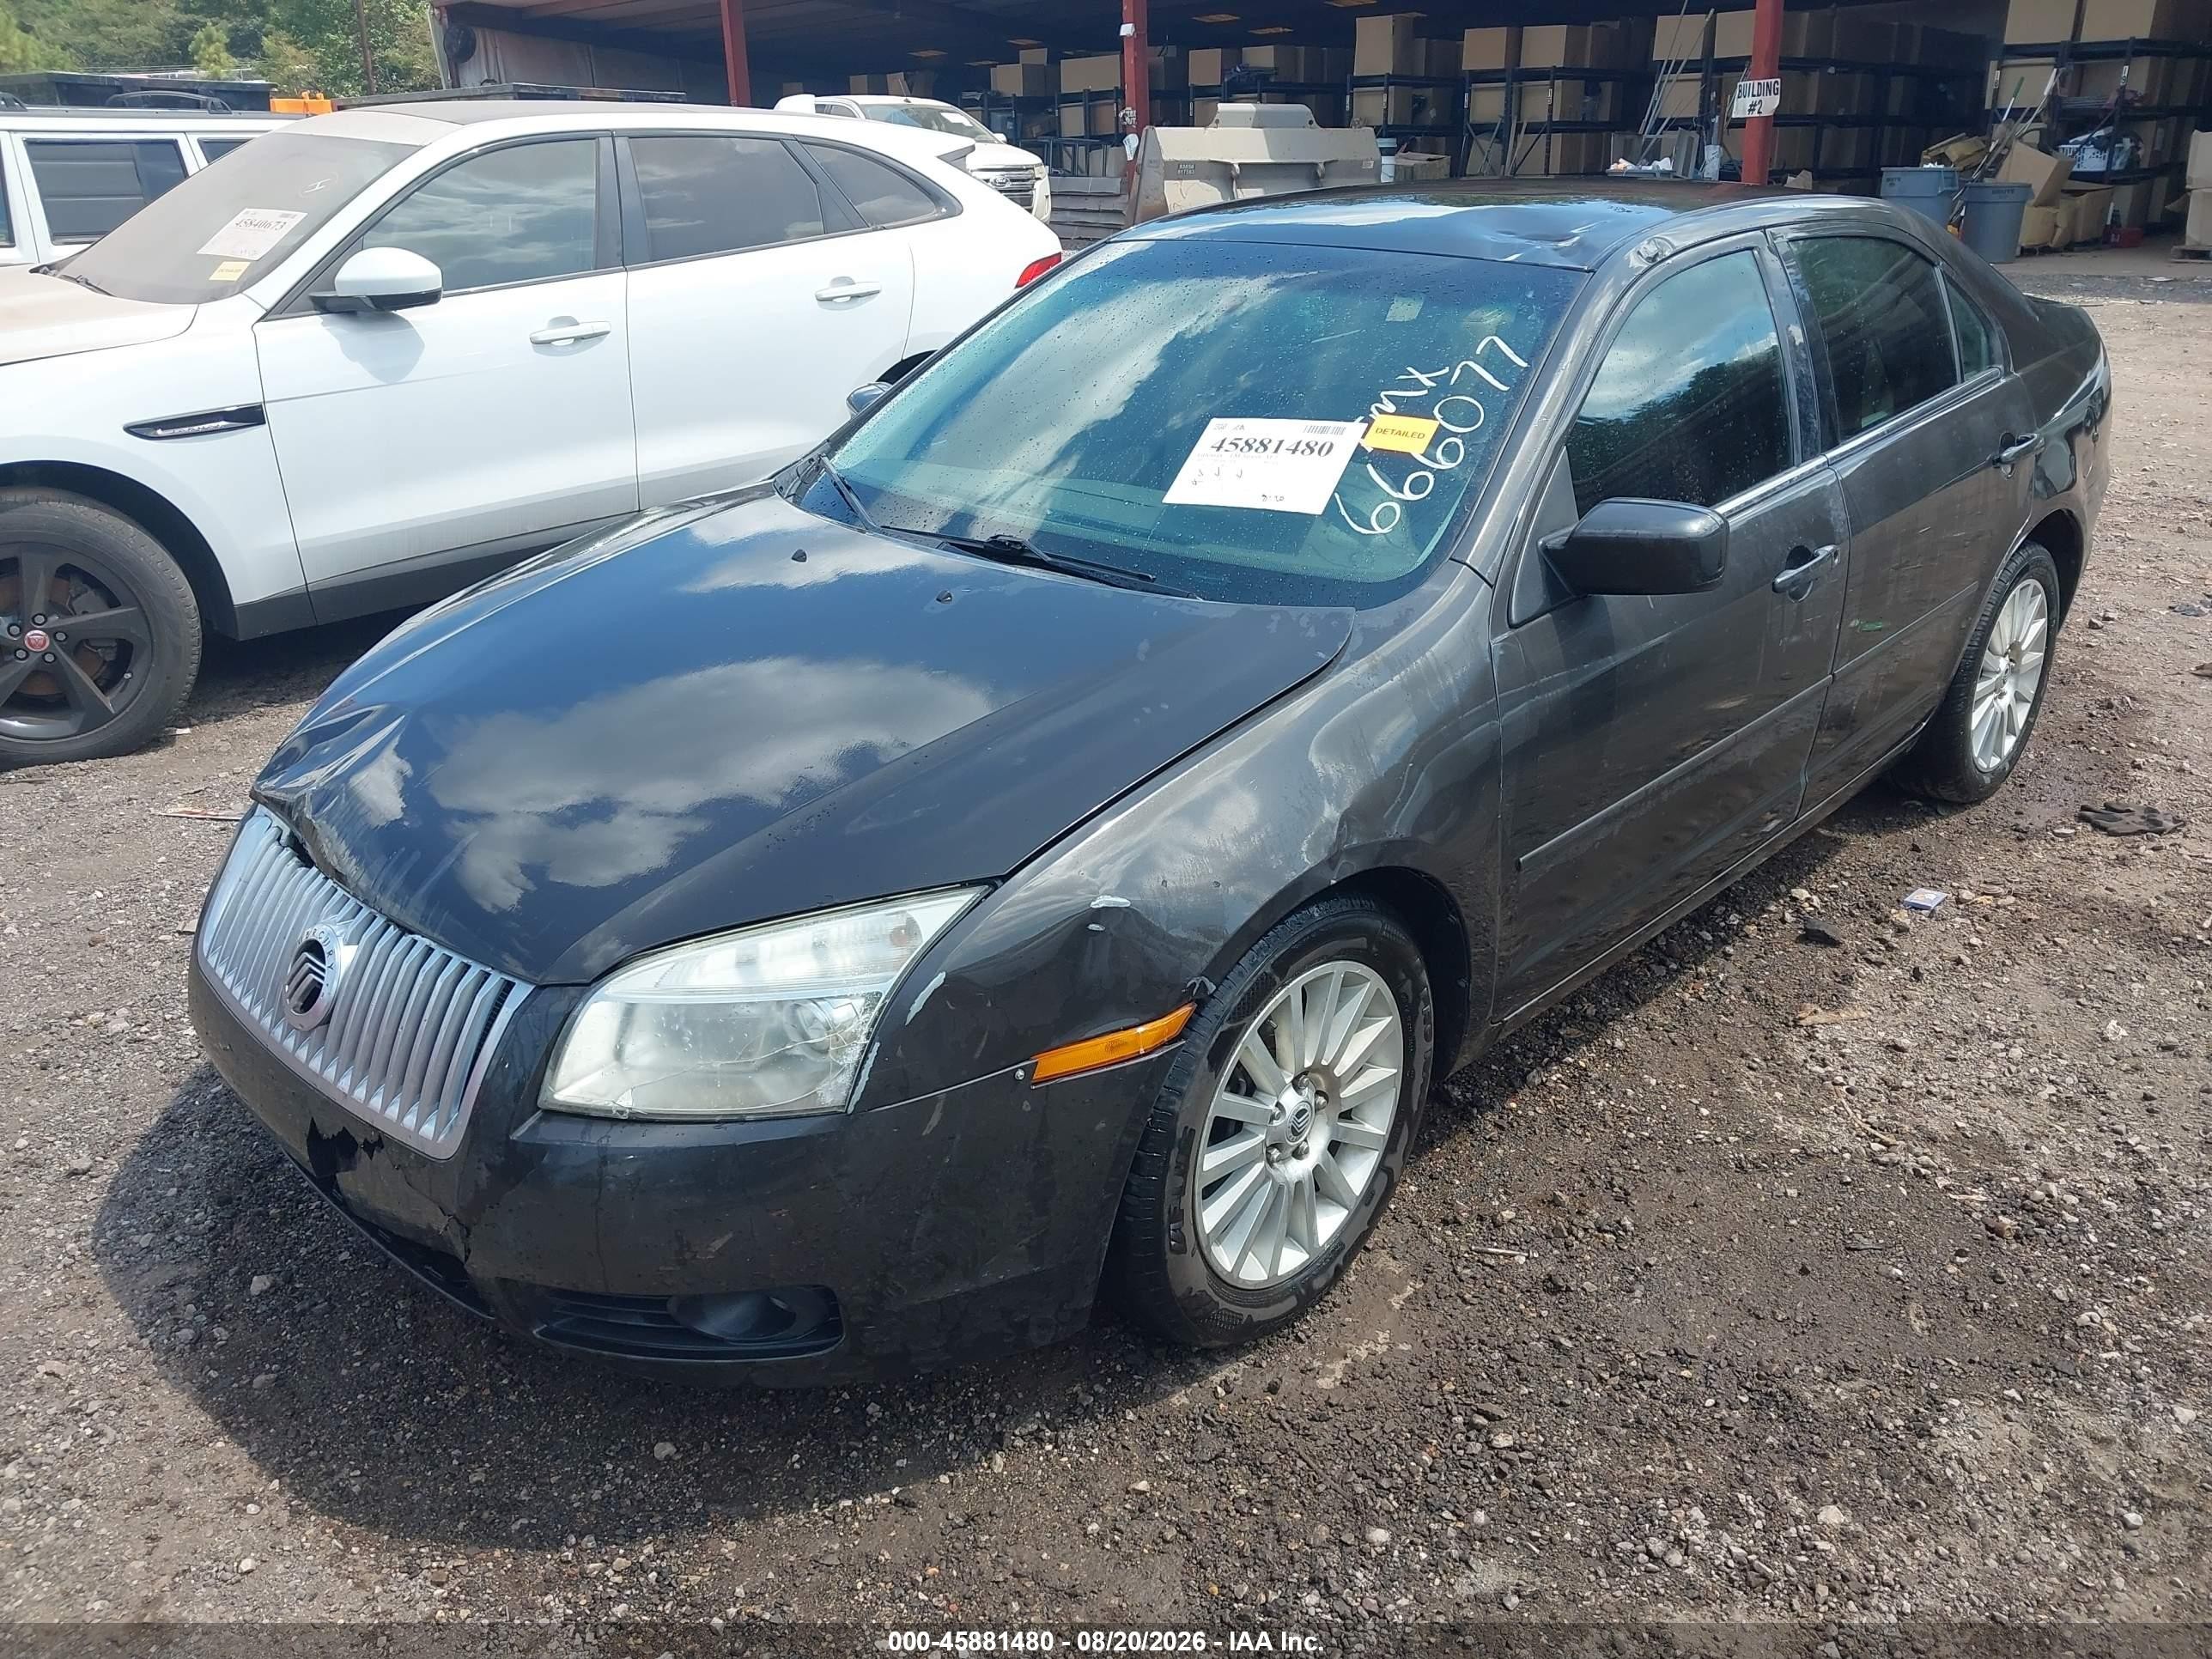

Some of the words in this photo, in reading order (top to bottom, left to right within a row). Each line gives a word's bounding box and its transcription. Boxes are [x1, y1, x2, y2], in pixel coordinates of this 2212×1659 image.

[1737, 80, 1779, 99] BUILDING
[1747, 100, 1763, 115] #2
[234, 218, 288, 231] 45840673
[1375, 427, 1425, 440] DETAILED
[1211, 437, 1334, 457] 45881480
